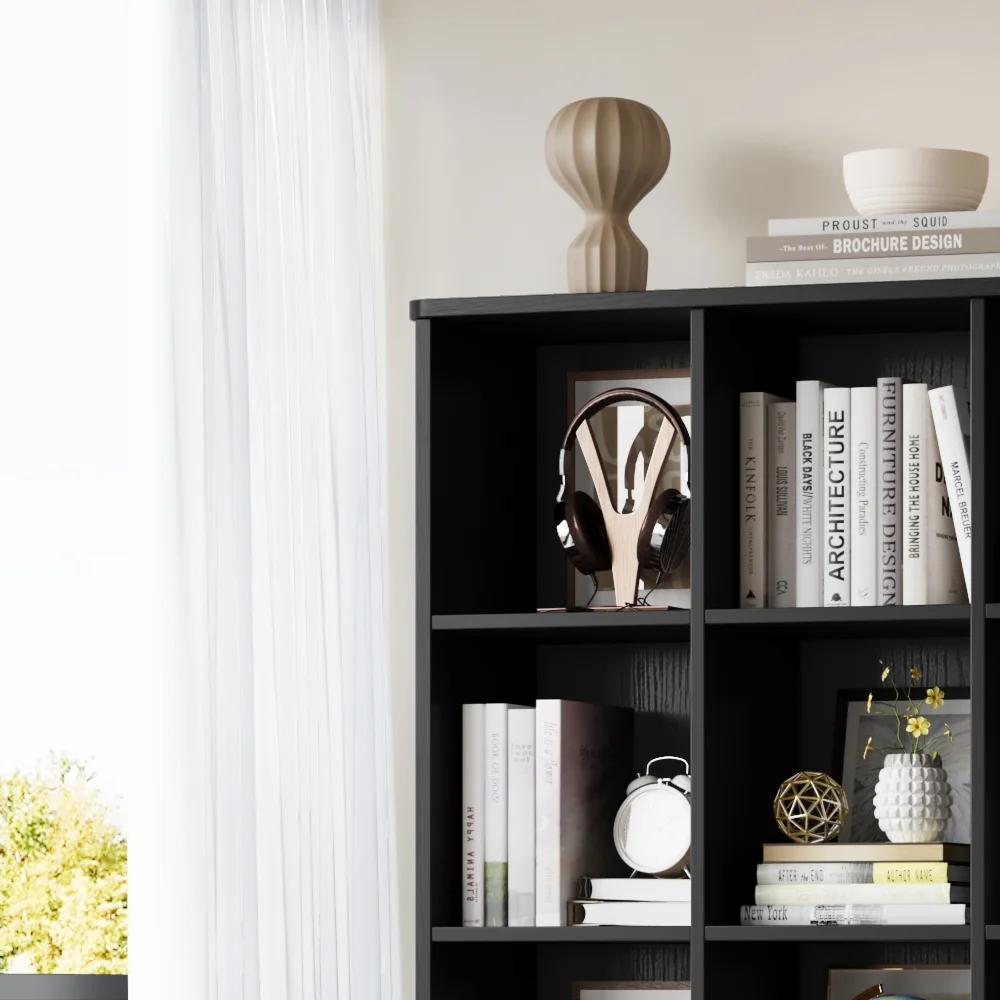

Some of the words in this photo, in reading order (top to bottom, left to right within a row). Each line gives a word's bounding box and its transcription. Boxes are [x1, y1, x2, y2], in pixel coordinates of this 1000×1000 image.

[821, 218, 878, 232] PROUST
[913, 215, 948, 228] SQUID
[832, 235, 908, 254] BROCHURE
[911, 233, 963, 250] DESIGN
[801, 433, 813, 464] BLACK
[882, 381, 896, 516] FURNITURE
[908, 434, 920, 460] HOME
[745, 456, 756, 523] KINFOLK
[776, 466, 788, 485] LOUIS
[908, 462, 920, 493] HOUSE
[776, 485, 788, 516] SULLIVAN
[827, 409, 845, 582] ARCHITECTURE
[908, 495, 920, 514] THE
[951, 461, 964, 500] MARCEL
[958, 500, 973, 540] BREUER
[908, 515, 920, 559] BRINGING
[882, 522, 896, 606] DESIGN
[776, 580, 788, 596] CCA
[778, 869, 798, 882] AFTER
[810, 869, 824, 882] END
[743, 906, 764, 921] New
[767, 905, 788, 921] York
